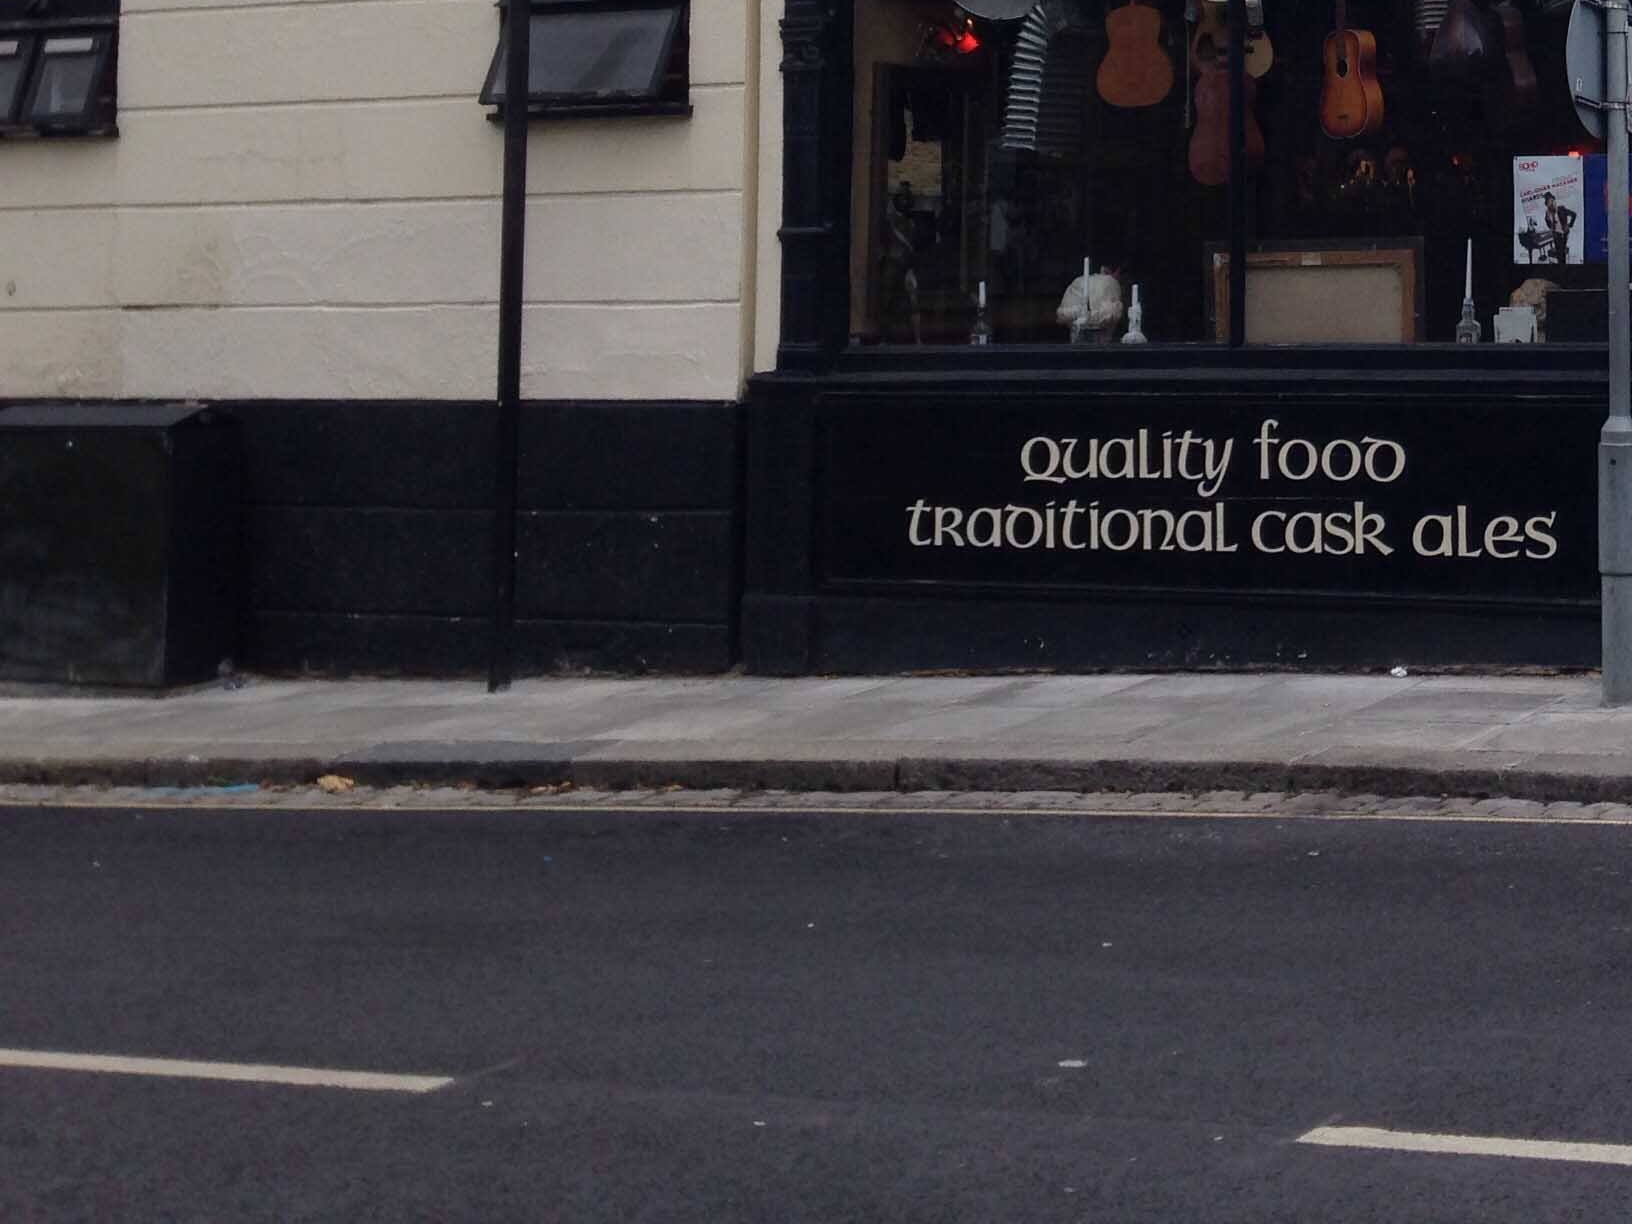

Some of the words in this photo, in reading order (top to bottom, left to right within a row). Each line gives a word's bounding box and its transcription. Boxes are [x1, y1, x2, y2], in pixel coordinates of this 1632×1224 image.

[1253, 418, 1406, 482] food
[906, 497, 1238, 554] traditional
[1251, 500, 1394, 558] cask
[1412, 505, 1558, 560] ales
